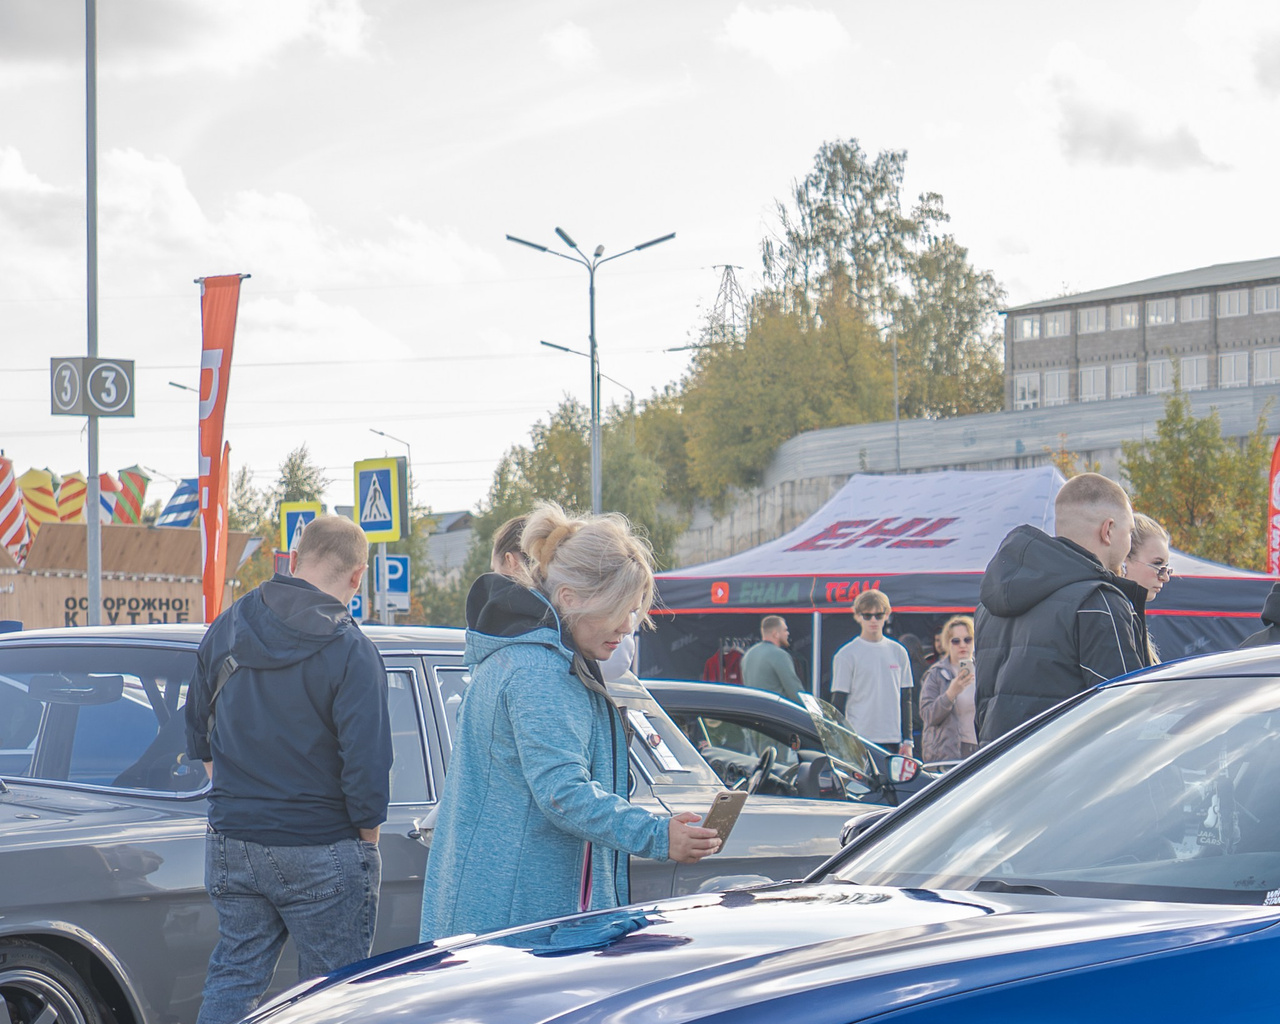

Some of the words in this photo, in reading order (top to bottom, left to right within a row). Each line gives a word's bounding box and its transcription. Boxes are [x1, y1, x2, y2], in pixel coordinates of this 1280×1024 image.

[61, 369, 71, 402] 3
[100, 370, 117, 403] 3
[783, 516, 960, 553] EHL
[64, 597, 189, 611] ОСОРОЖНО!
[739, 581, 800, 603] EHALA
[64, 611, 189, 627] КУТЫЕ
